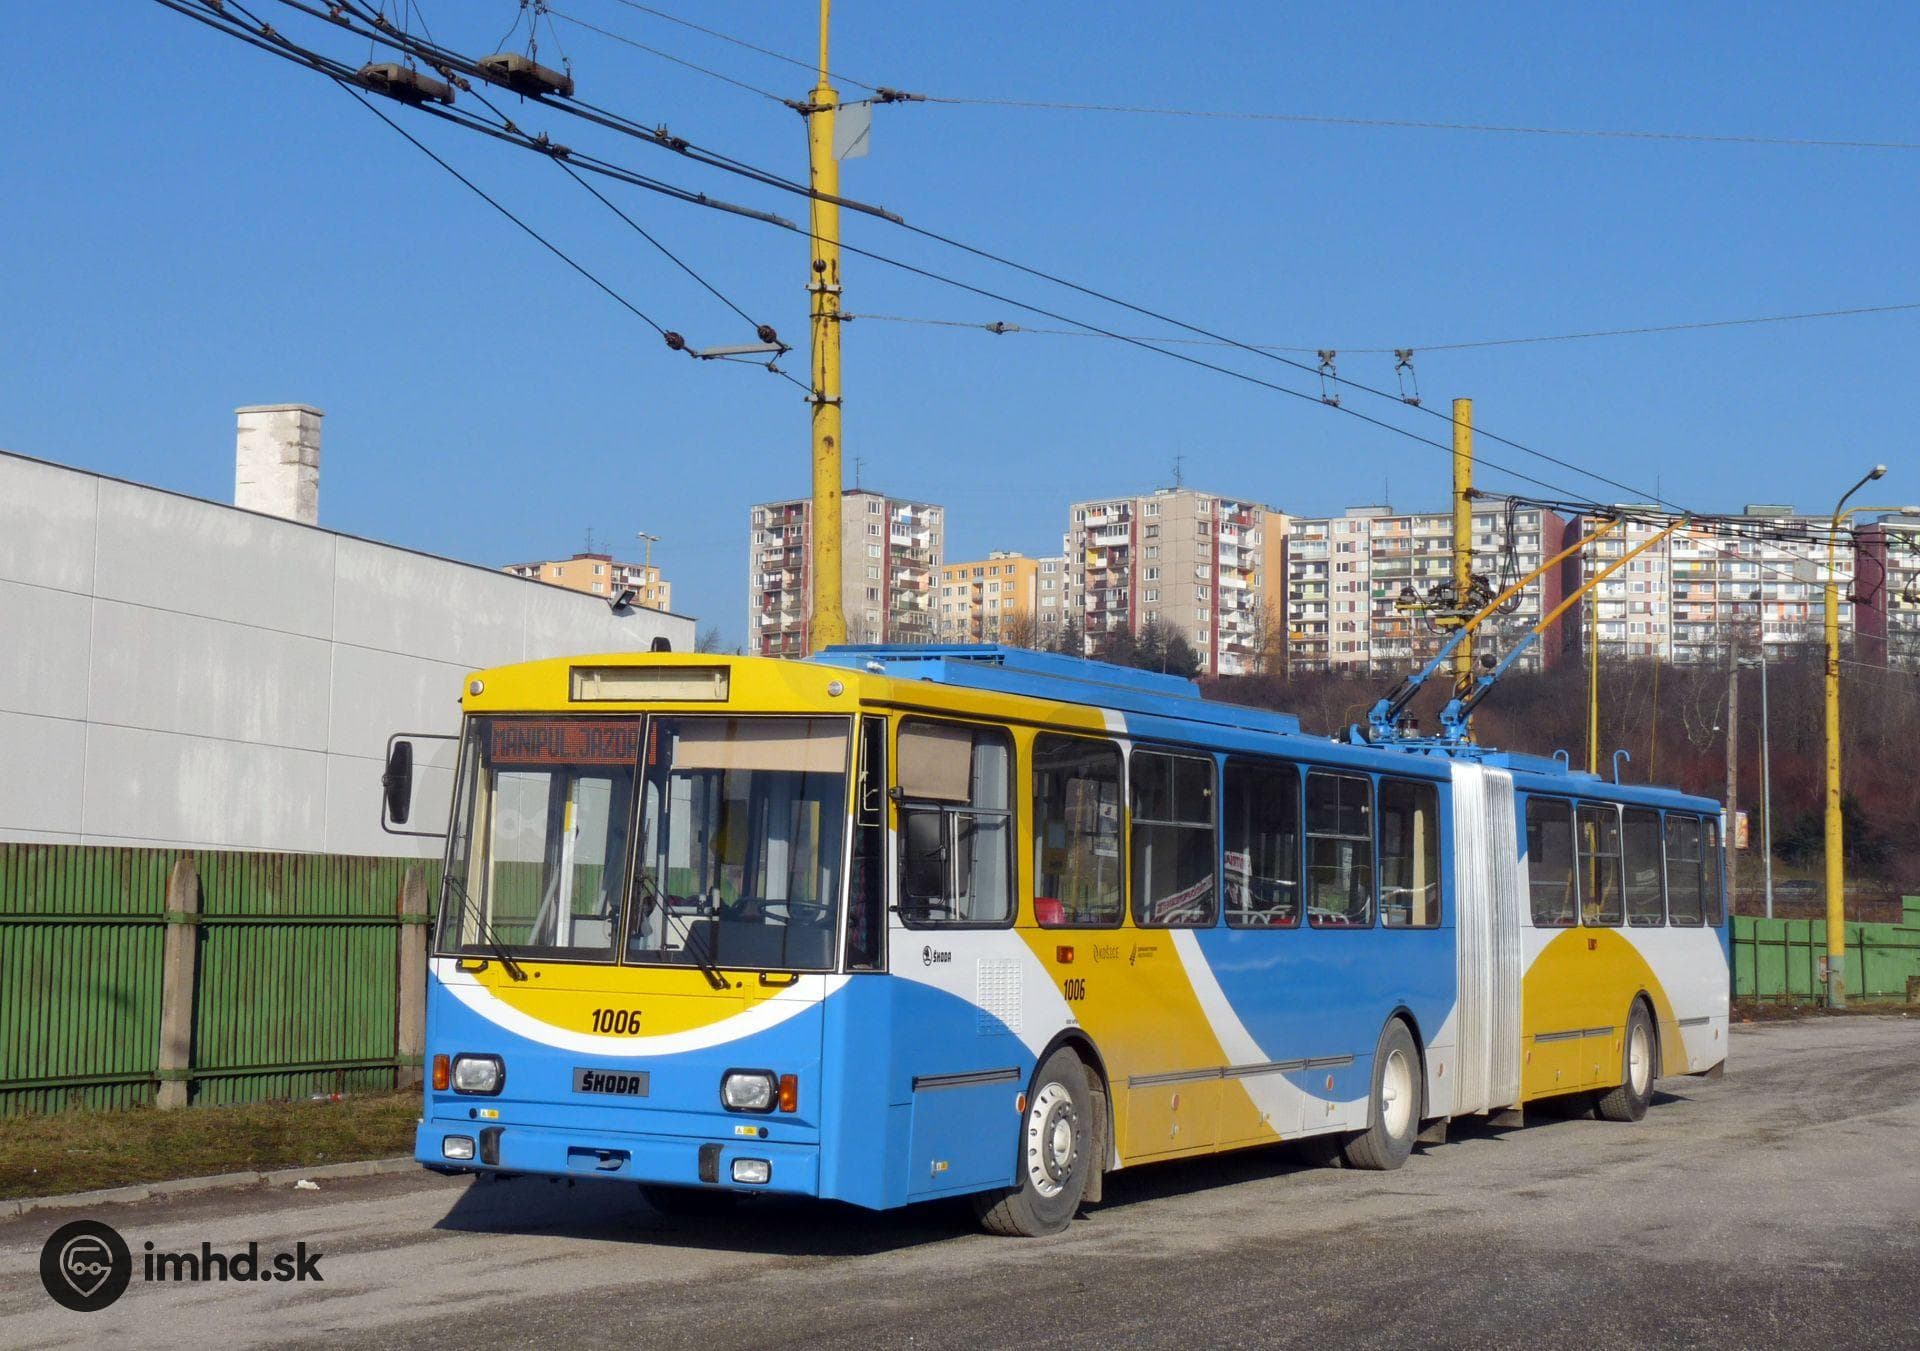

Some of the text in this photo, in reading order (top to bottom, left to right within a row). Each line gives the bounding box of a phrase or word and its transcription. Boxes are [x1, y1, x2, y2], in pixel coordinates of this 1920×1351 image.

[933, 950, 952, 963] ŠKODA
[1064, 979, 1085, 1001] 1006
[592, 1008, 642, 1035] 1006
[582, 1070, 641, 1095] ŠKODA
